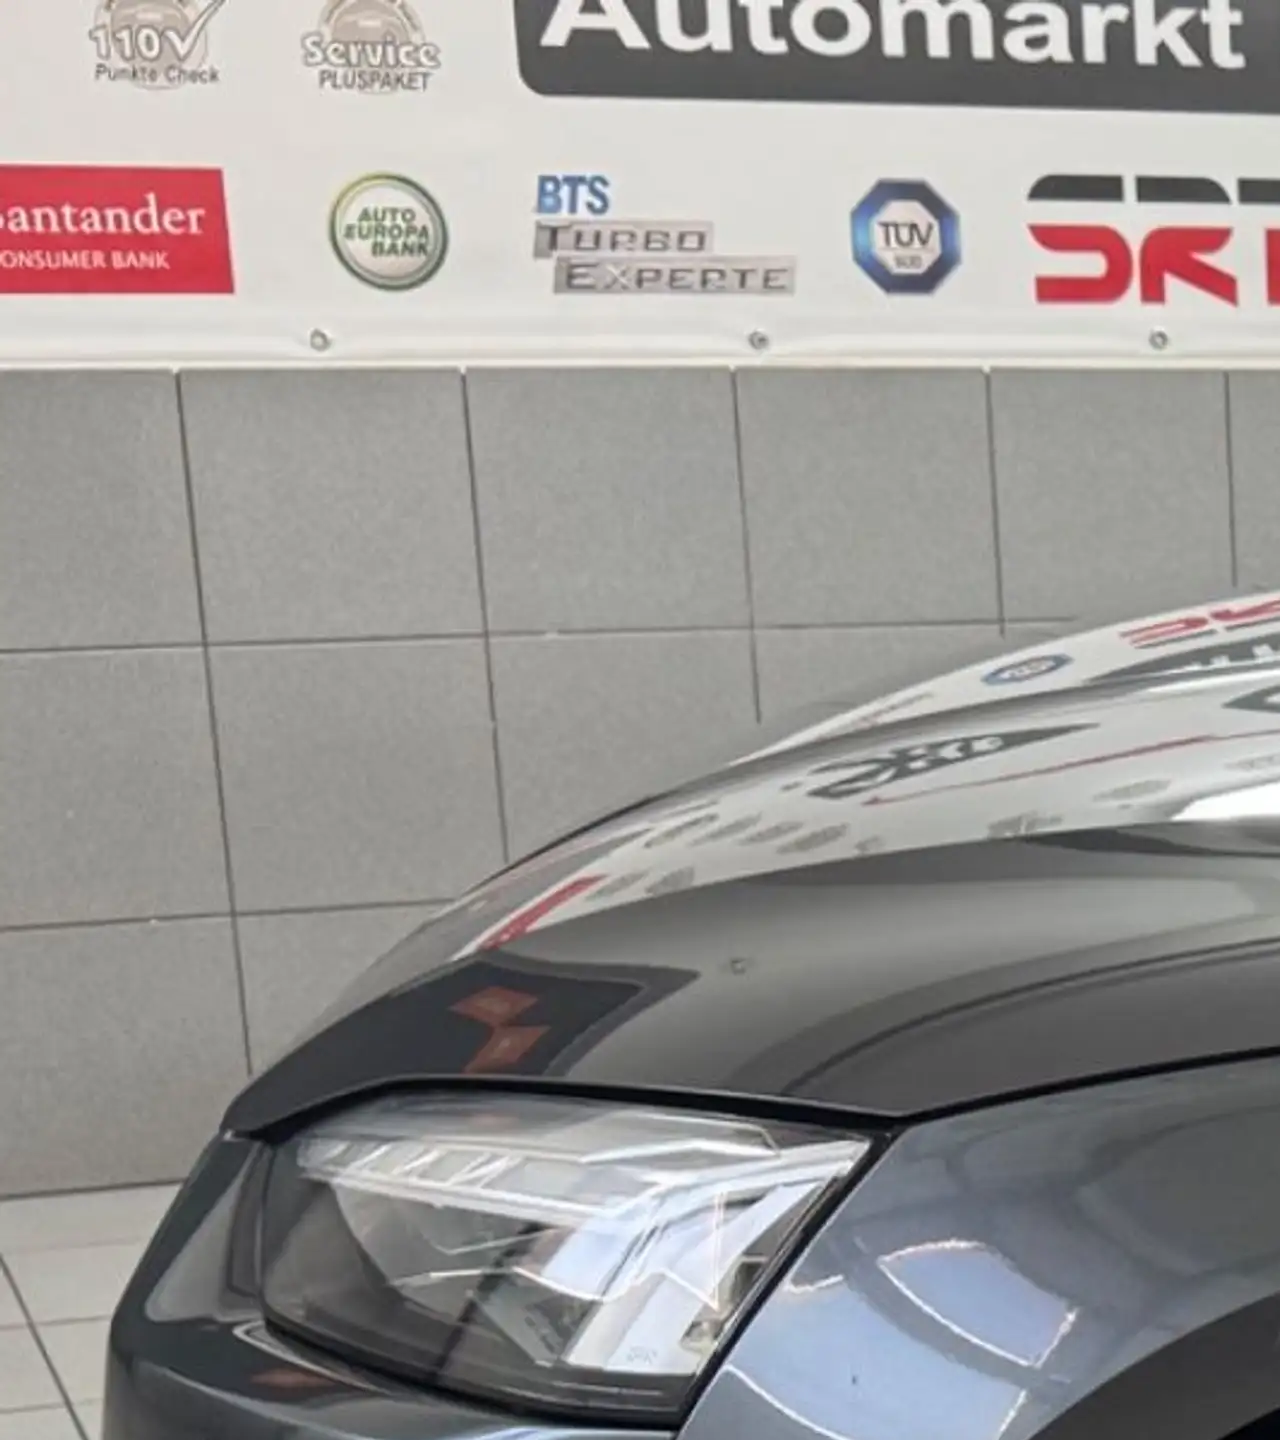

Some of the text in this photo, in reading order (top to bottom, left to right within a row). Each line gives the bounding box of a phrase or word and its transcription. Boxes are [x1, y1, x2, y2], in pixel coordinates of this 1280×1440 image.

[541, 0, 1245, 71] Automarkt
[302, 32, 442, 68] Service
[95, 63, 220, 85] Punkte Check
[318, 69, 433, 91] PLUSPAKET
[536, 174, 610, 215] BTS
[0, 191, 206, 236] antander
[357, 206, 416, 222] AUTO
[343, 224, 429, 241] EUROPA
[0, 249, 170, 270] ONSUMER BANK
[371, 241, 428, 257] BANK
